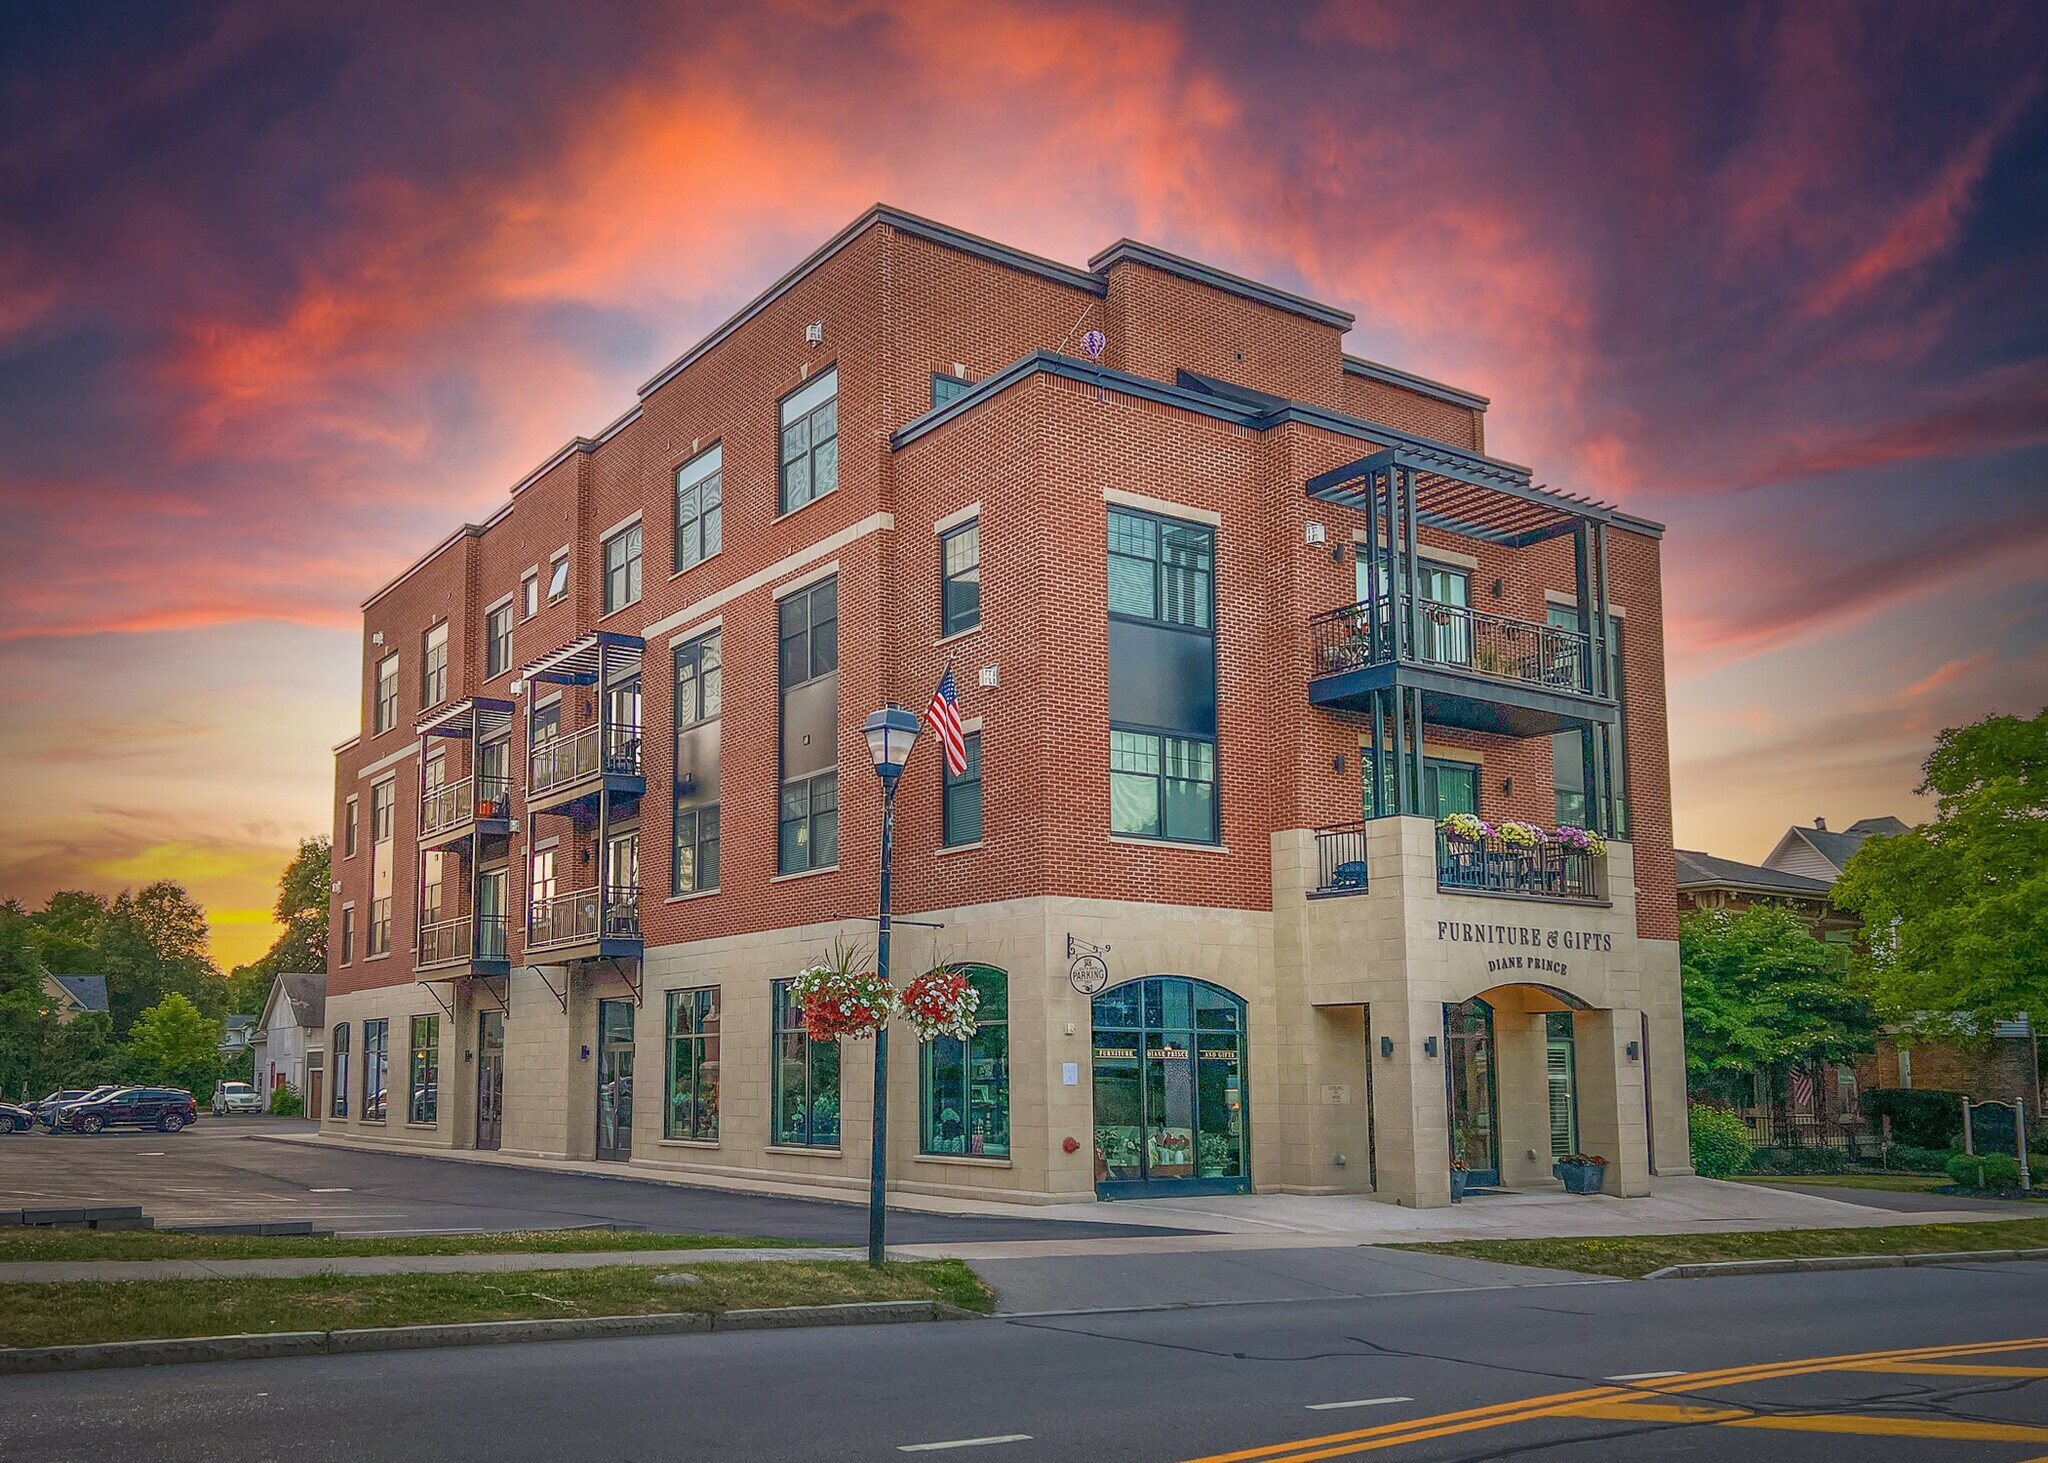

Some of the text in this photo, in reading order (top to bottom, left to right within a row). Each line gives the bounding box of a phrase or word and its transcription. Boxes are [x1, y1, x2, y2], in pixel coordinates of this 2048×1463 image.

[1437, 921, 1612, 952] FURNITURE & GIFTS
[1072, 969, 1105, 981] PARKING
[1488, 956, 1568, 976] DIANE PRINCE
